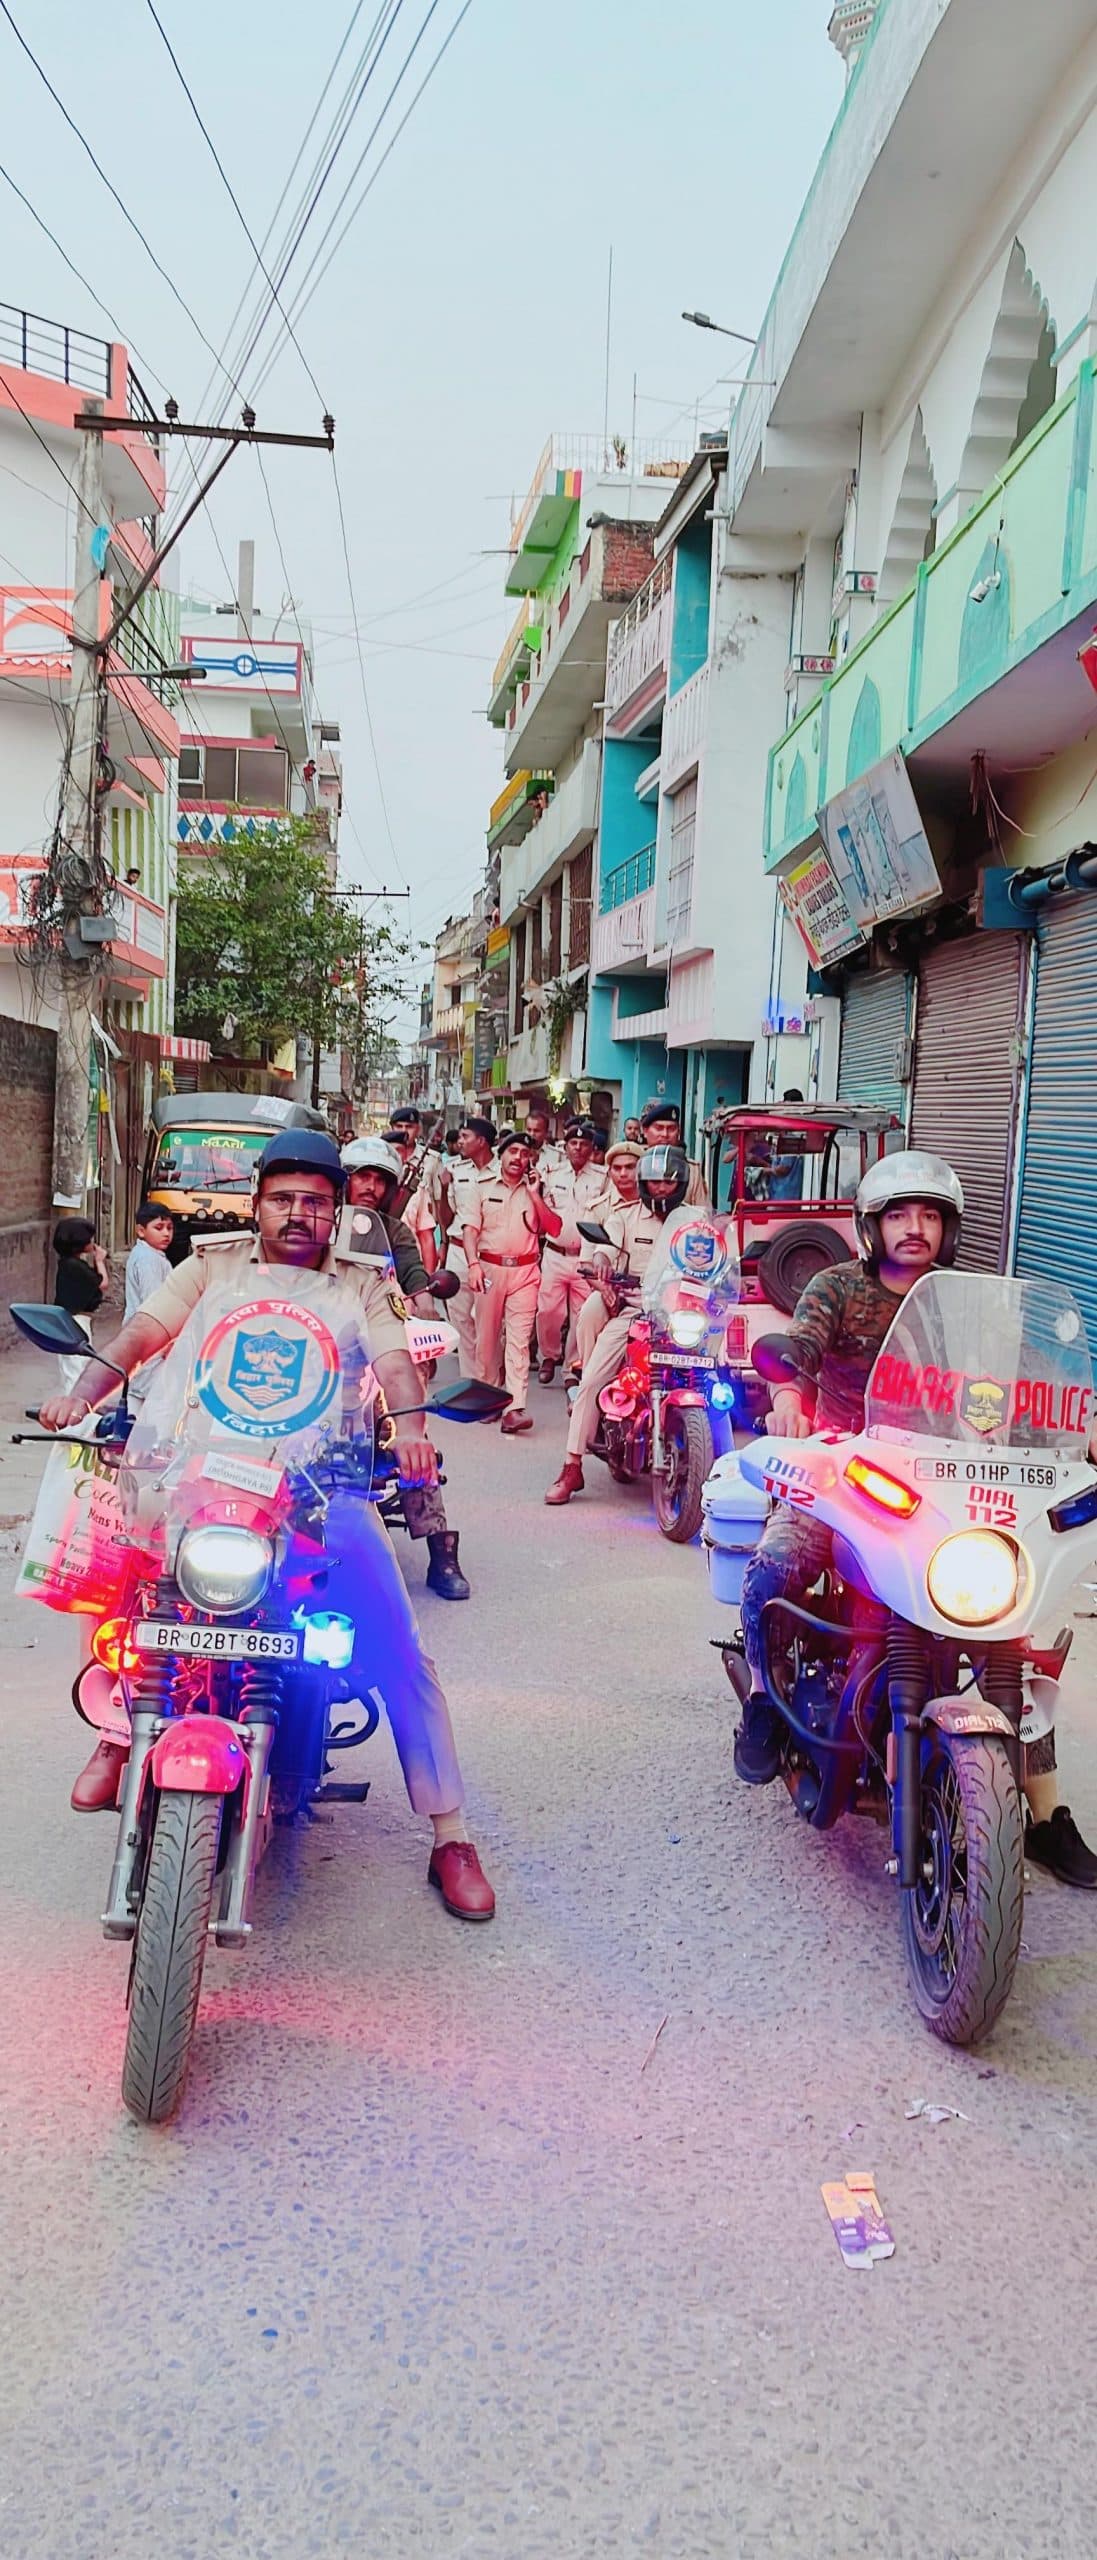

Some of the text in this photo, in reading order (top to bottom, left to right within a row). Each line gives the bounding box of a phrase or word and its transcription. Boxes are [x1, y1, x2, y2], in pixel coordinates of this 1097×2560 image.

[266, 1301, 323, 1332] पुलिस
[414, 1333, 444, 1346] DIAL
[413, 1346, 446, 1361] 112
[871, 1353, 1093, 1434] BIHAR POLICE
[221, 1412, 291, 1436] बिहार
[765, 1456, 818, 1490] DIAL
[936, 1462, 1054, 1485] BR 01HP 1658
[763, 1475, 815, 1508] 112
[969, 1485, 1019, 1511] DIAL
[964, 1504, 1017, 1529] 112
[157, 1628, 294, 1655] BR 02BT 8693
